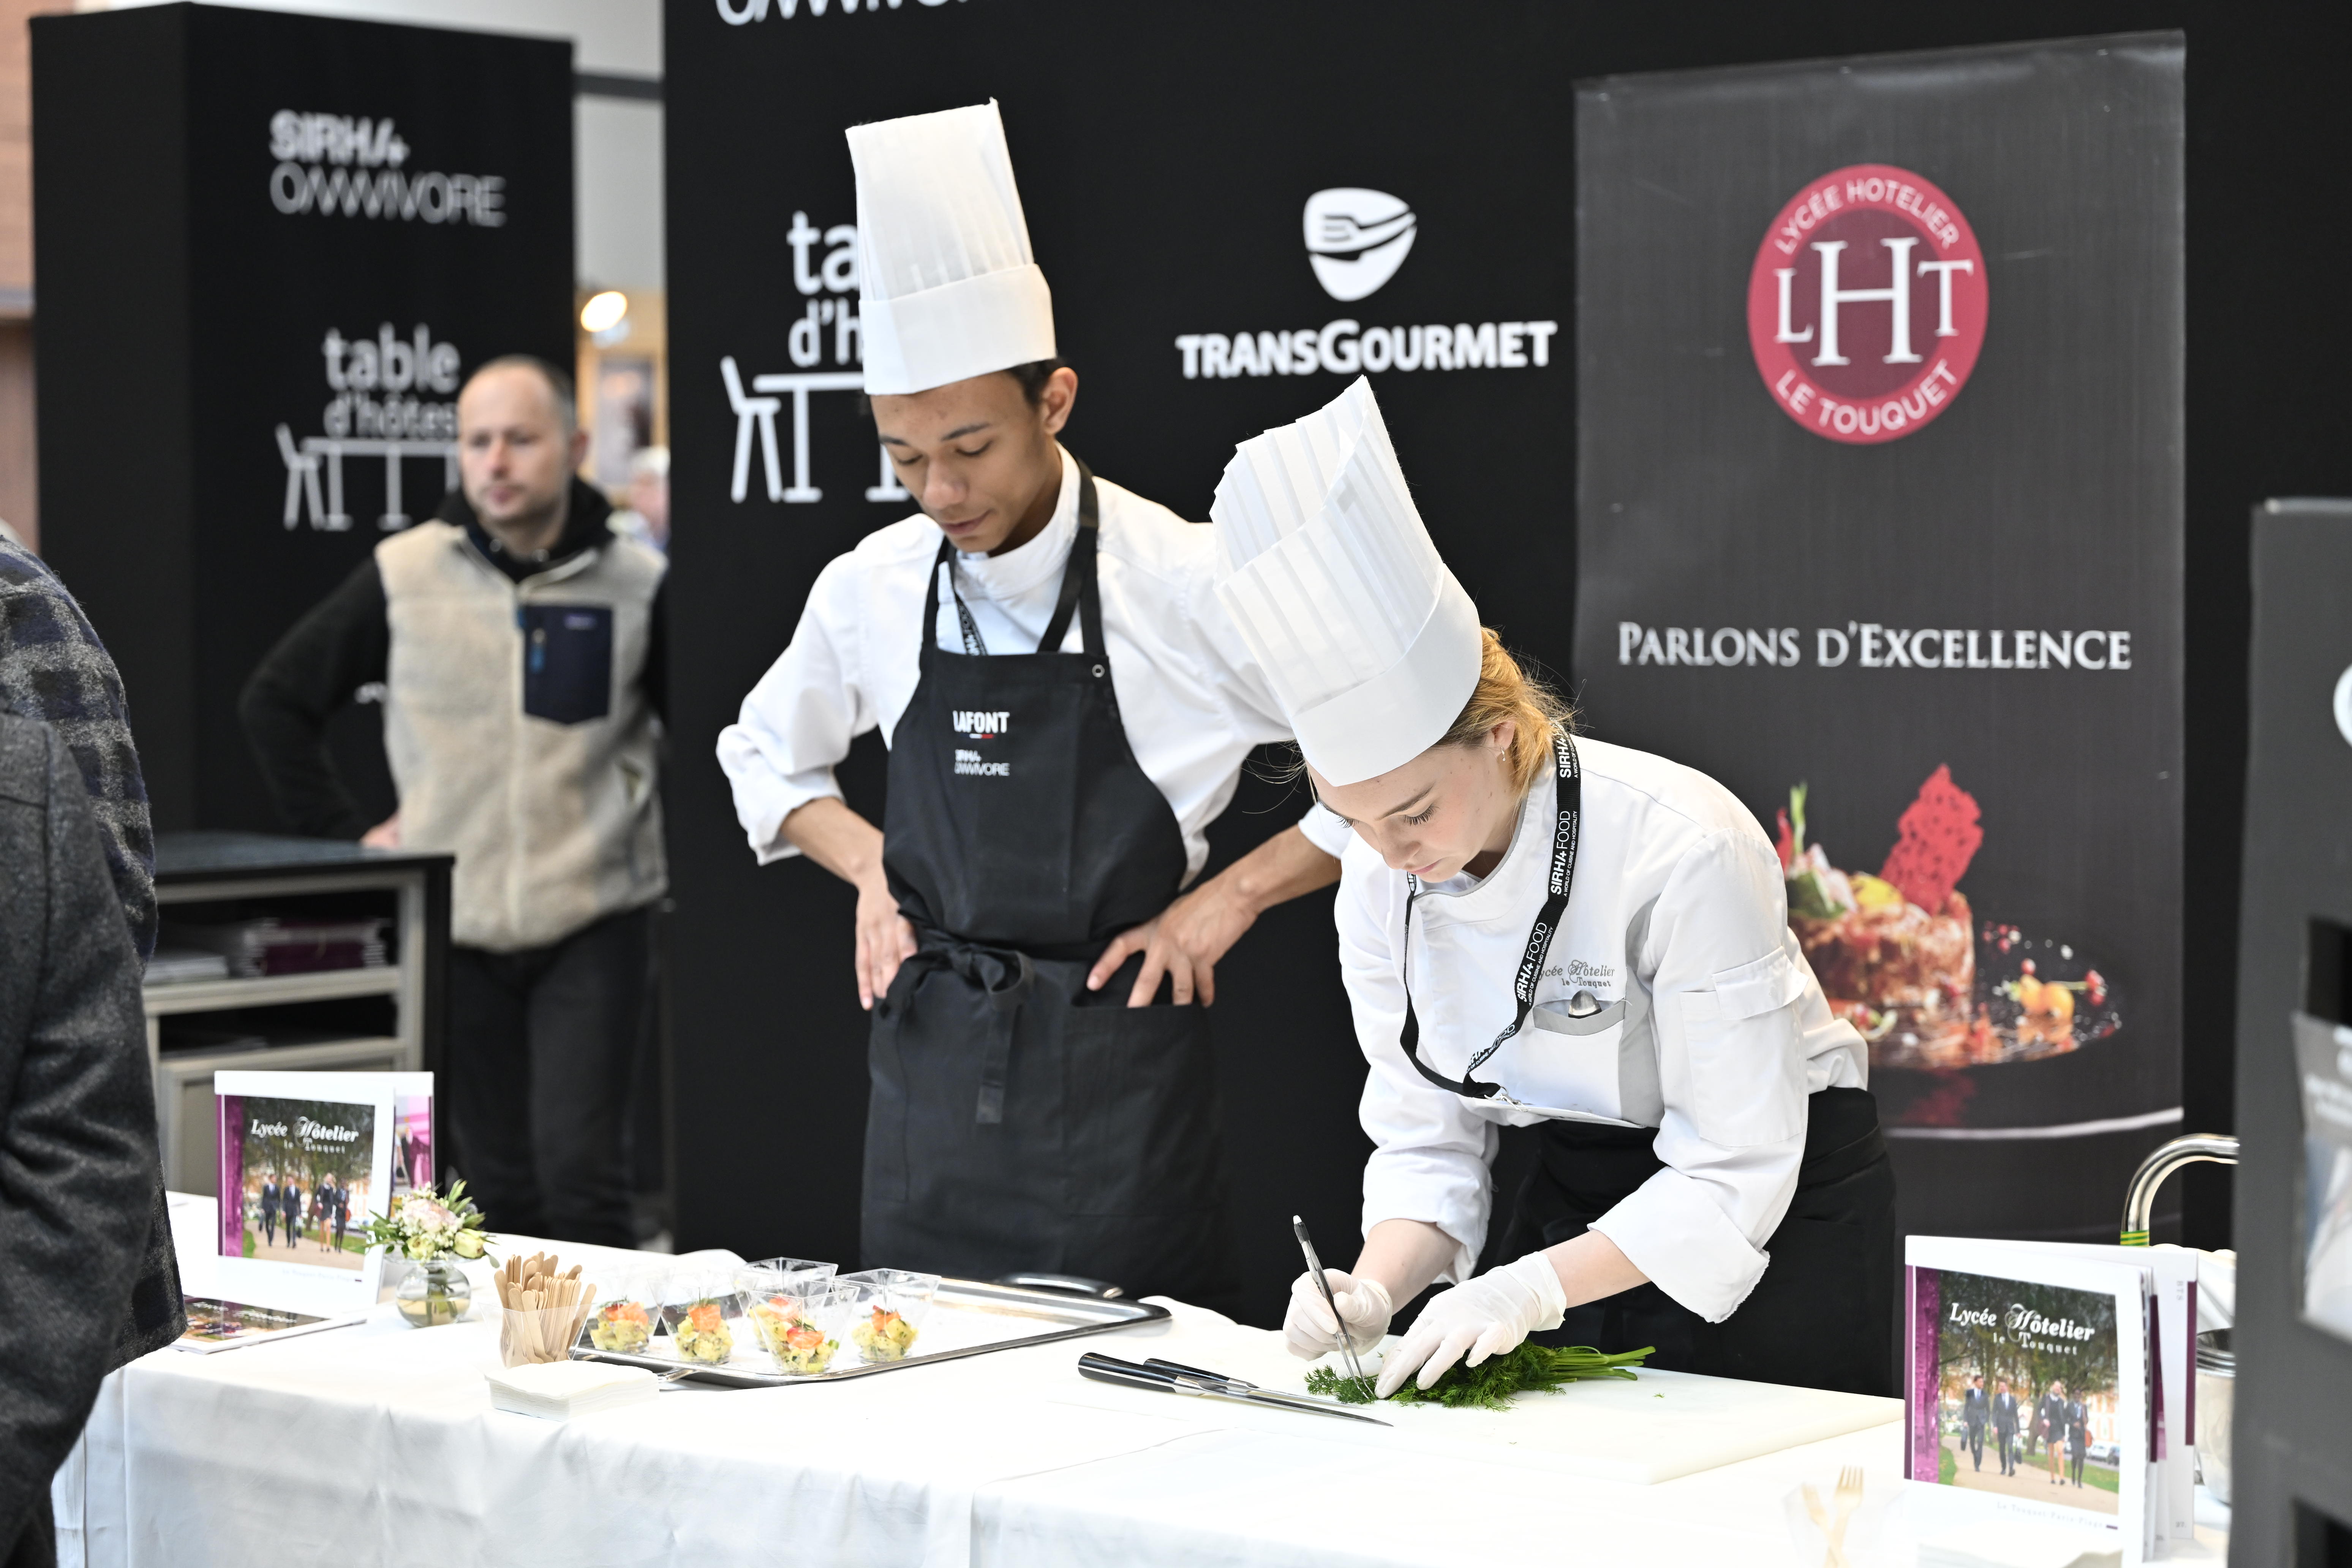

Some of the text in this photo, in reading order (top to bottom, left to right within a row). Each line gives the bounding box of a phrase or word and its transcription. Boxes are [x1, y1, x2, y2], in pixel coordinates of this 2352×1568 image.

[1774, 177, 1959, 255] LYCÉE HOTELIER
[321, 321, 461, 394] table
[1776, 359, 1957, 435] LE TOUQUET
[1556, 811, 1570, 849] FOOD
[1526, 922, 1547, 961] FOOD
[1532, 964, 1541, 982] CUISINE
[1541, 926, 1553, 954] HOSPITALITY
[1538, 959, 1615, 980] ycée Hôtelier
[1578, 977, 1611, 988] Touquet
[251, 1116, 359, 1142] Lycée Hôtelier
[1949, 1302, 2096, 1341] Lycée Hôtelier
[1993, 1331, 2078, 1356] le Touquet
